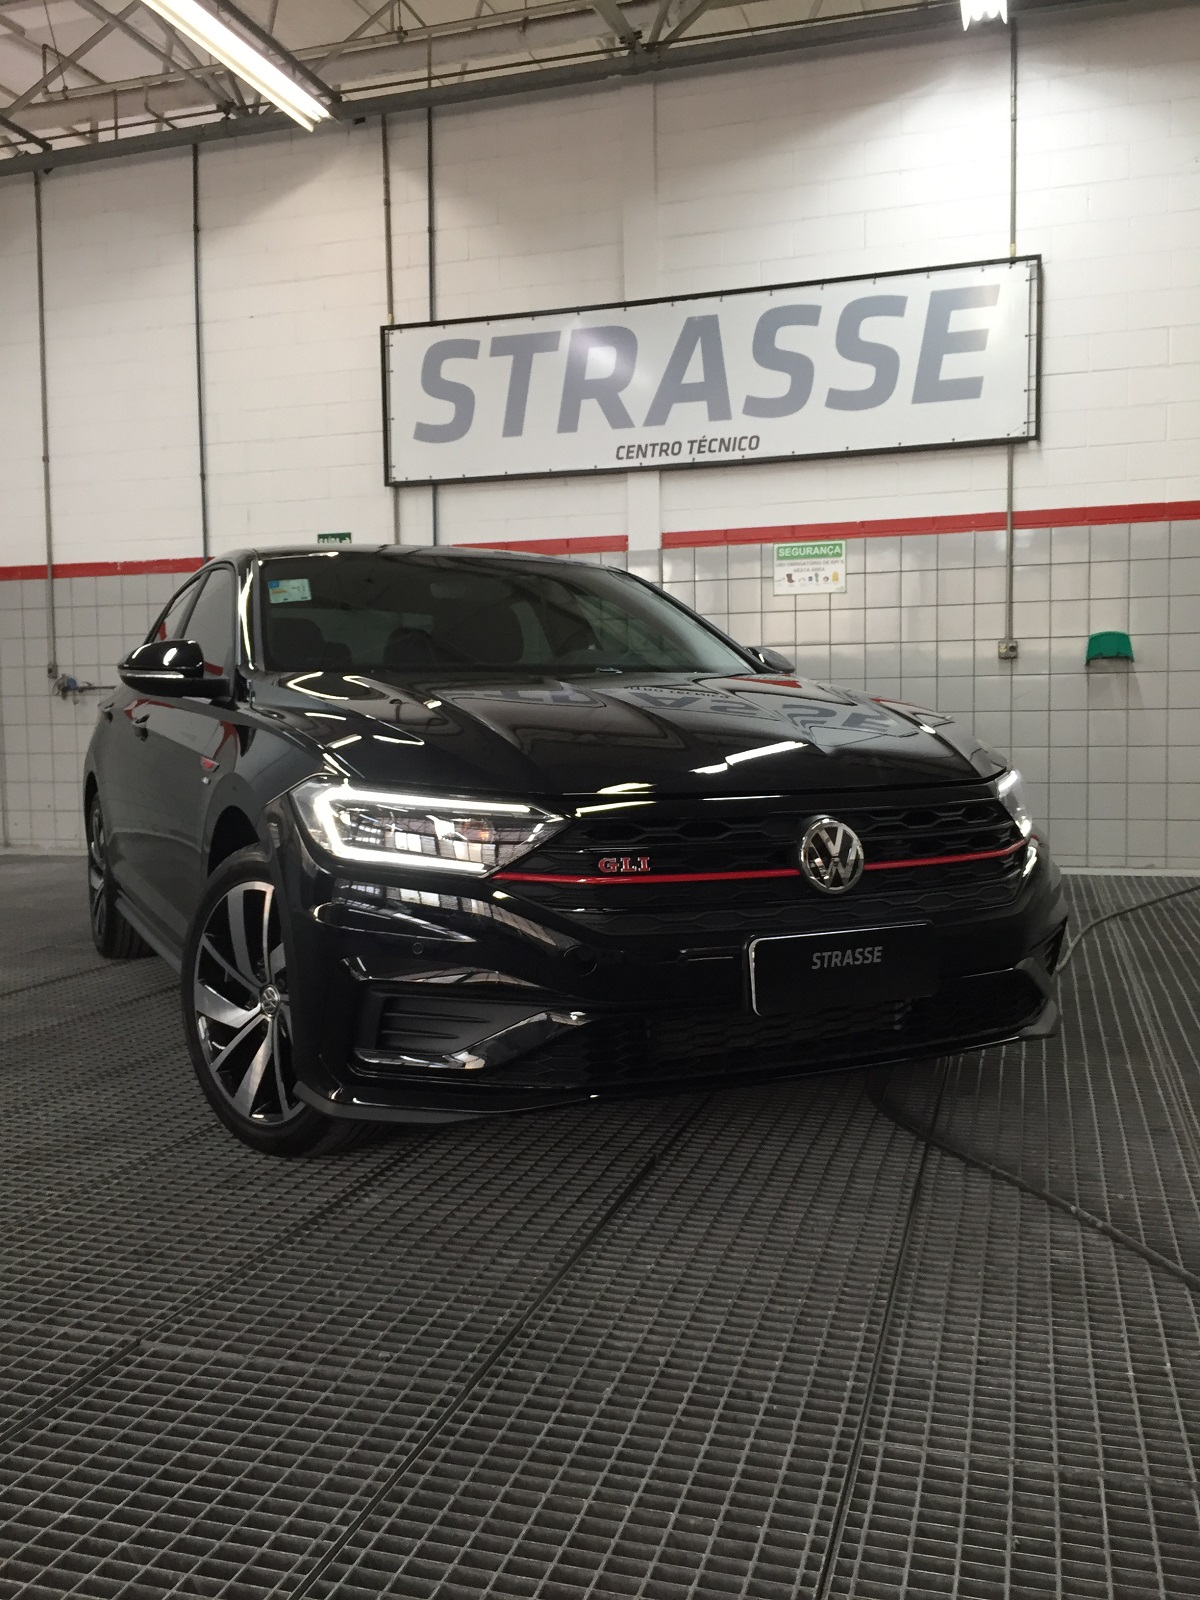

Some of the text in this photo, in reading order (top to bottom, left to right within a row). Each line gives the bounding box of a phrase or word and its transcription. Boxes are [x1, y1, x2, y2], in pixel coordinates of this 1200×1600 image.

[412, 284, 1000, 444] STRASSE
[615, 435, 760, 460] CENTRO TÉCNICO
[778, 545, 841, 557] SEGURANÇA
[598, 857, 650, 873] GLI
[811, 946, 883, 970] STRASSE
